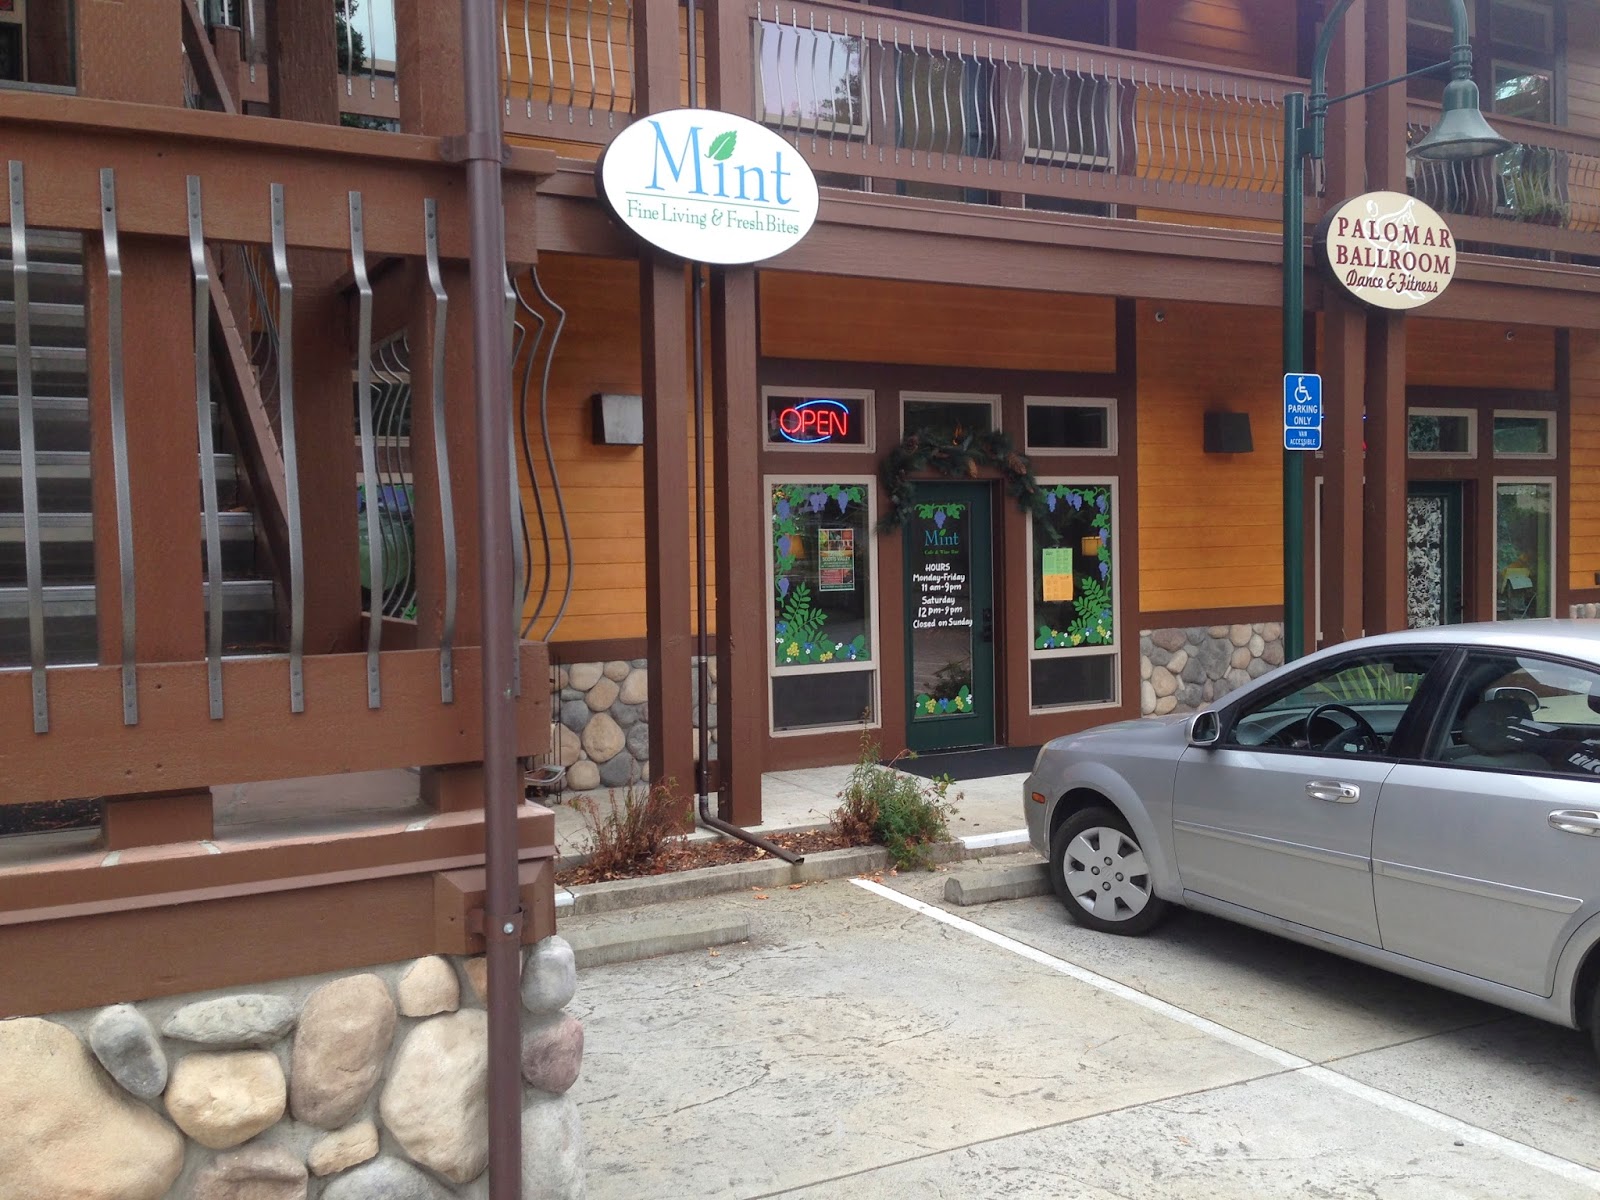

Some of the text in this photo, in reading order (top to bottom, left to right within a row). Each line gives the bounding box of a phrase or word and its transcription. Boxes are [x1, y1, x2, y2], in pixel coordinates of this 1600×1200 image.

[645, 120, 792, 205] Mint
[627, 199, 799, 235] Fine Living & Fresh Bites
[1337, 216, 1451, 249] PALOMAR
[1336, 244, 1451, 275] BALLROOM
[1345, 268, 1439, 293] Dance & Fitness
[1287, 404, 1318, 414] PARKING
[780, 408, 848, 437] OPEN
[1293, 416, 1312, 425] ONLY
[1290, 438, 1316, 446] ACCESSIBLE
[924, 529, 960, 547] Mint
[925, 563, 951, 572] HOURS
[912, 573, 966, 583] Monday-Friday
[921, 595, 956, 605] Saturday
[912, 619, 936, 629] Closed
[948, 617, 973, 627] Sunday
